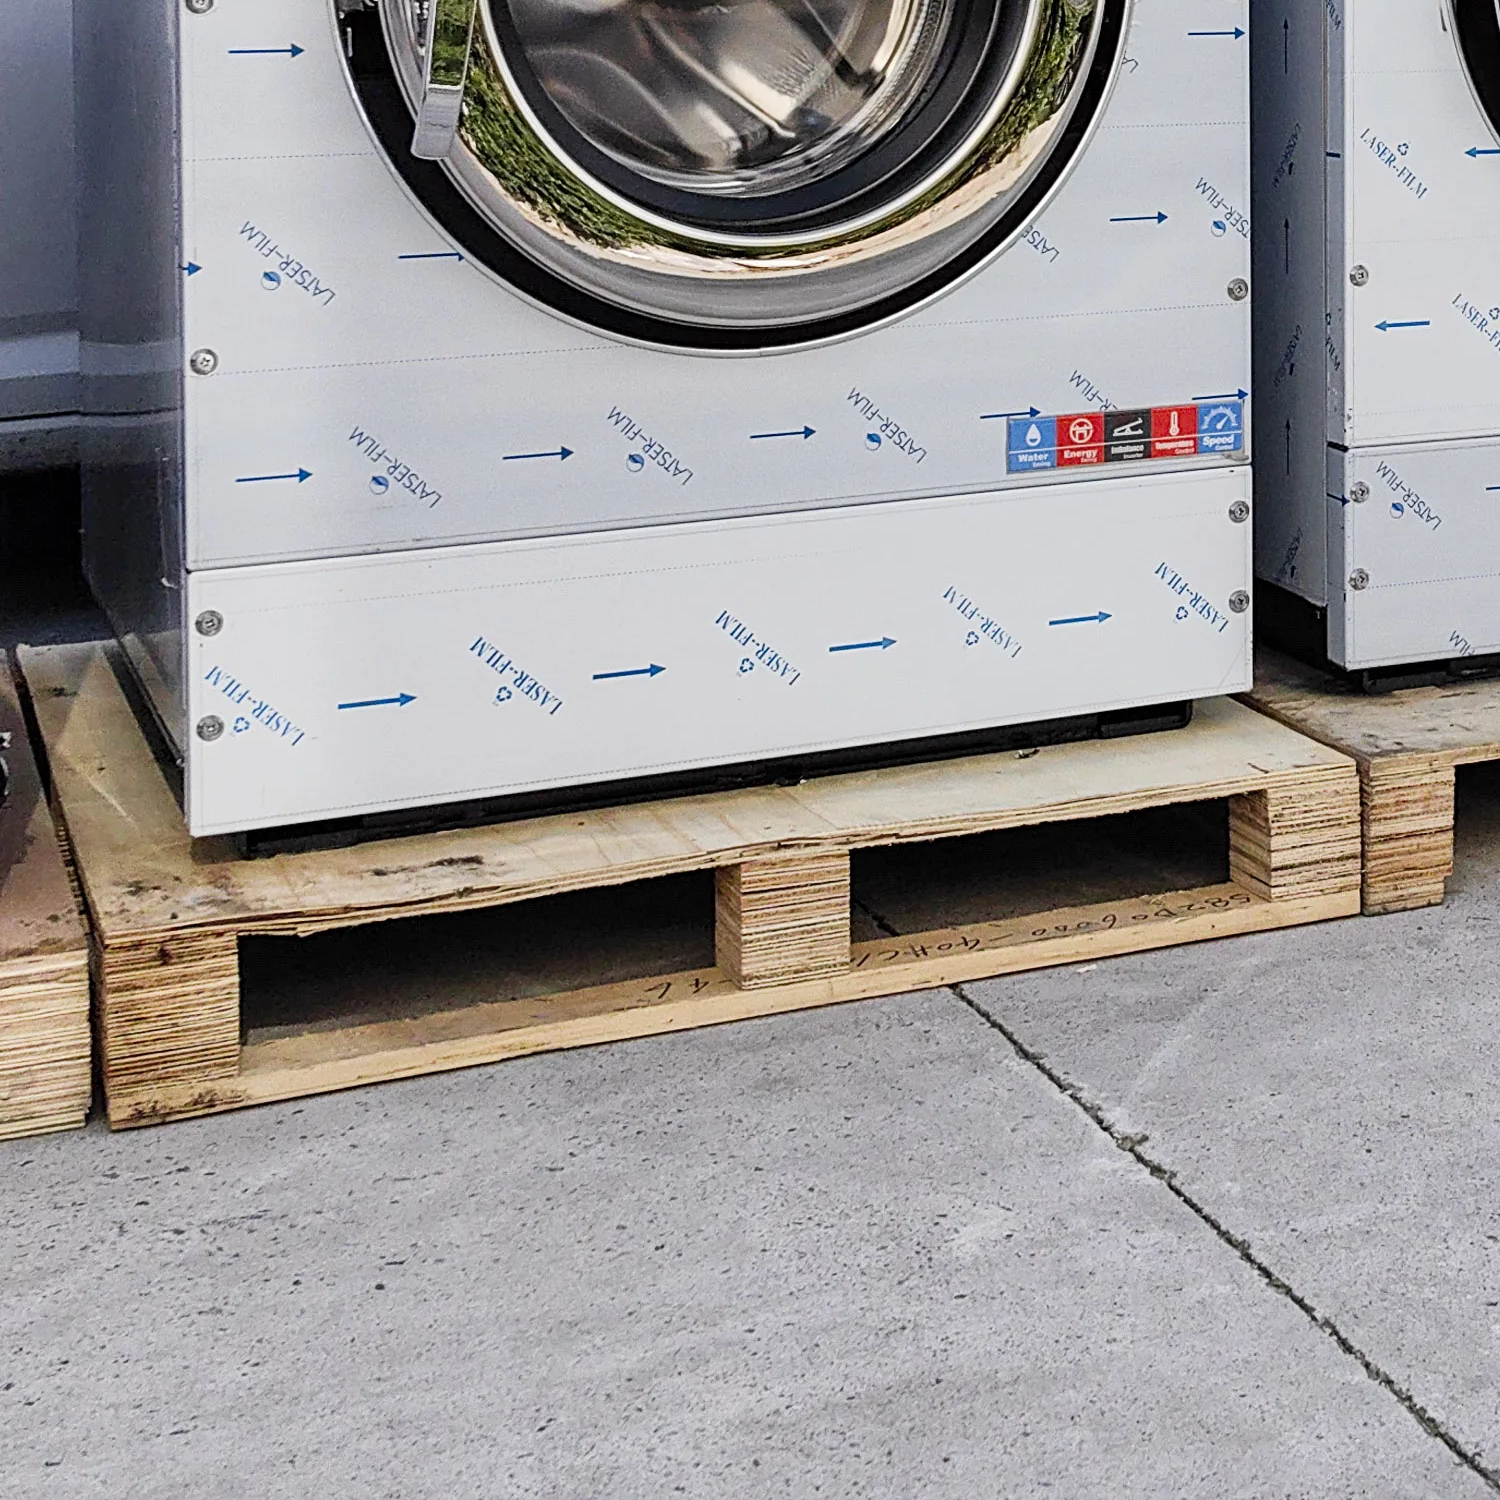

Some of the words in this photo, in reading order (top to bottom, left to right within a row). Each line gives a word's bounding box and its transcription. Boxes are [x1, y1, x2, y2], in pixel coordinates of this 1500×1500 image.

[1202, 435, 1235, 446] Speed
[1017, 453, 1048, 462] Water
[1064, 449, 1098, 459] Energy
